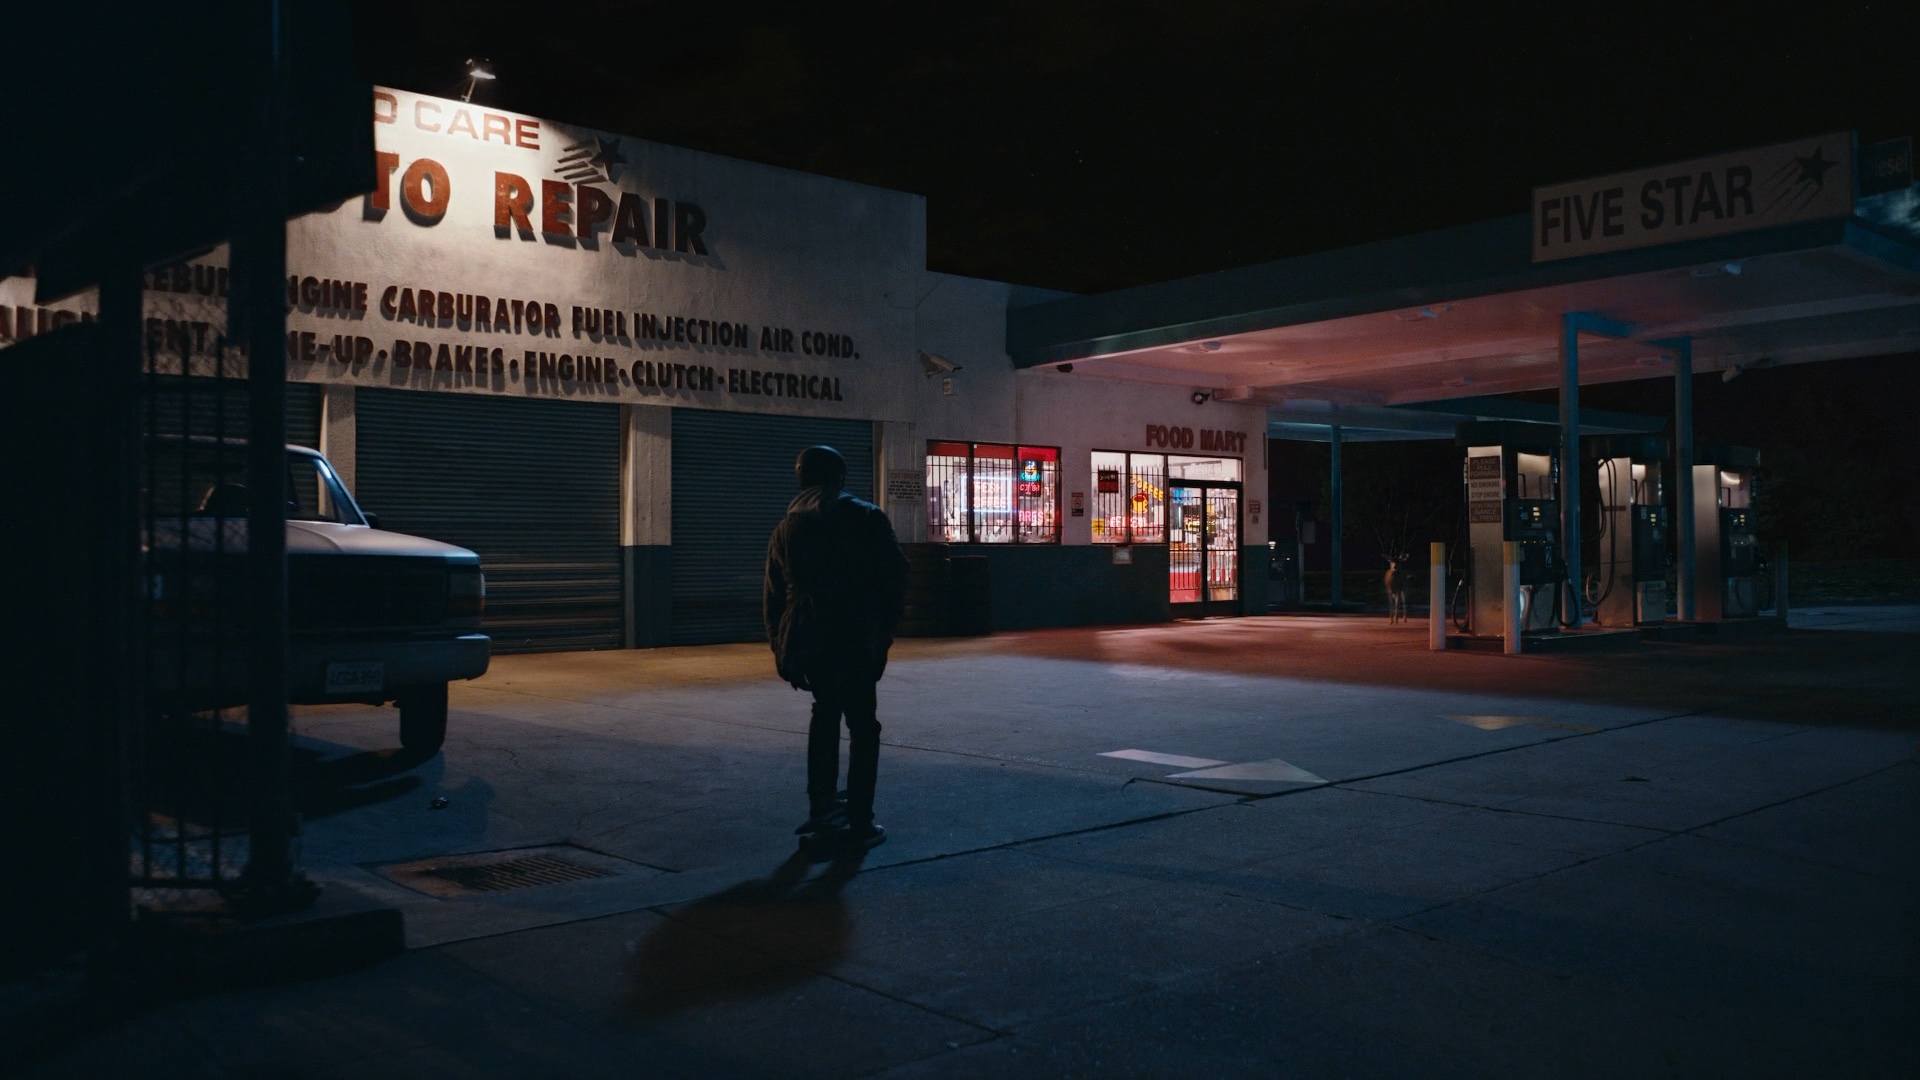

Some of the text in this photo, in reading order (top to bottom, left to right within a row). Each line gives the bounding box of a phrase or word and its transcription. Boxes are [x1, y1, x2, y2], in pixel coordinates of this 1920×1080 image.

[415, 99, 541, 151] CARE
[494, 171, 709, 257] REPAIR
[1541, 165, 1754, 247] FIVE STAR
[383, 285, 560, 332] CARBURATOR
[572, 306, 627, 338] FUEL
[633, 313, 748, 349] INJECTION
[760, 326, 794, 354] AIR
[801, 331, 860, 360] COND.
[394, 339, 505, 375] BRAKES
[523, 351, 618, 384] ENGINE
[632, 360, 714, 392] CLUTCH
[728, 368, 843, 402] ELECTRICAL
[1146, 424, 1247, 453] FOOD MART
